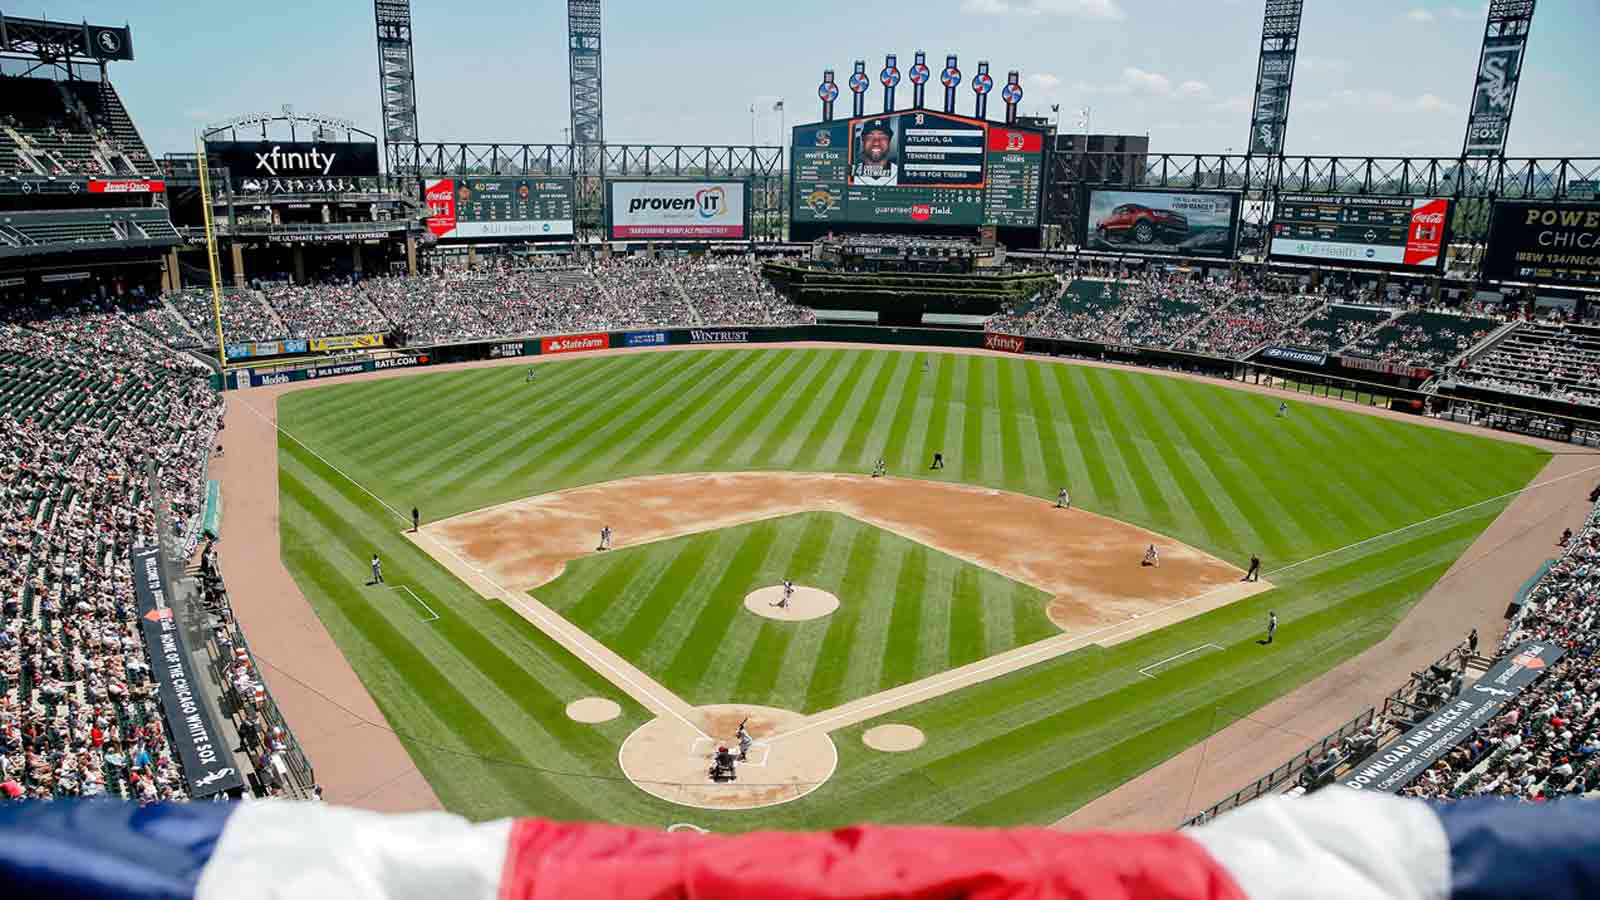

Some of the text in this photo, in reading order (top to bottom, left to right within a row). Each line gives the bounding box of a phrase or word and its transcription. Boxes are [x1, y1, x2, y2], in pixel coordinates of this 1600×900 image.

[1471, 128, 1499, 138] SOX
[907, 136, 941, 144] ATLANTA,
[255, 146, 336, 175] xfinity
[629, 195, 720, 213] proven IT
[689, 329, 749, 341] WINTRUST
[985, 335, 1024, 353] xfinity
[375, 356, 418, 369] RATE.COM
[1281, 350, 1322, 363] HYUNDAI
[262, 373, 289, 385] Modelo
[160, 633, 217, 765] HOME OF THE CHICAGO WHITE SOX
[1346, 700, 1473, 790] DOWNLOAD AND CHECK-IN
